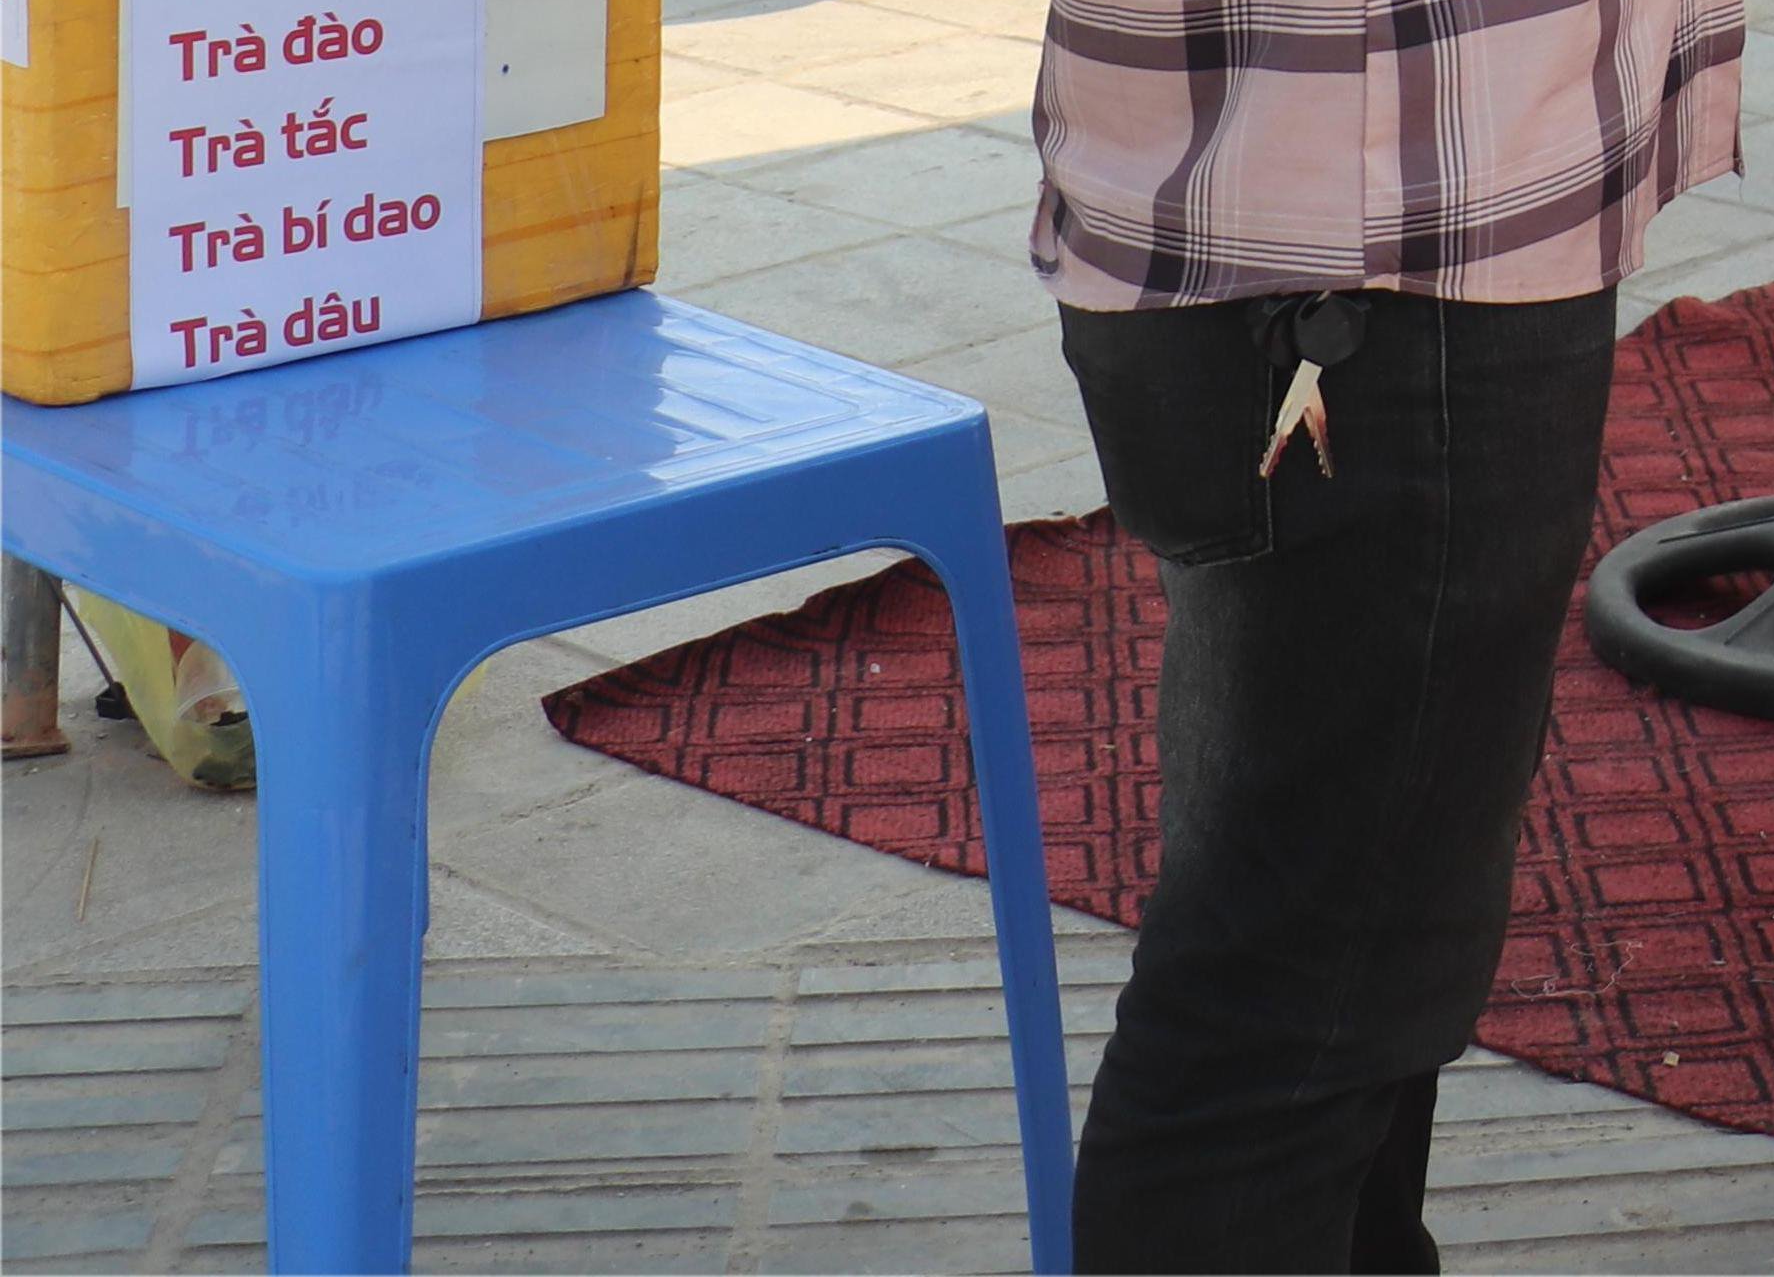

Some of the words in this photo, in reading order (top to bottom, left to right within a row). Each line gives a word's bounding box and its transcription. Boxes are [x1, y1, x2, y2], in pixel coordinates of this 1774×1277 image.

[170, 24, 266, 82] Trà
[284, 11, 384, 63] đào
[170, 121, 266, 178] Trà
[281, 97, 368, 157] tắc
[170, 213, 265, 273] Trà
[284, 199, 331, 254] bí
[344, 193, 441, 244] dao
[170, 308, 267, 368] Trà
[284, 292, 381, 346] dâu
